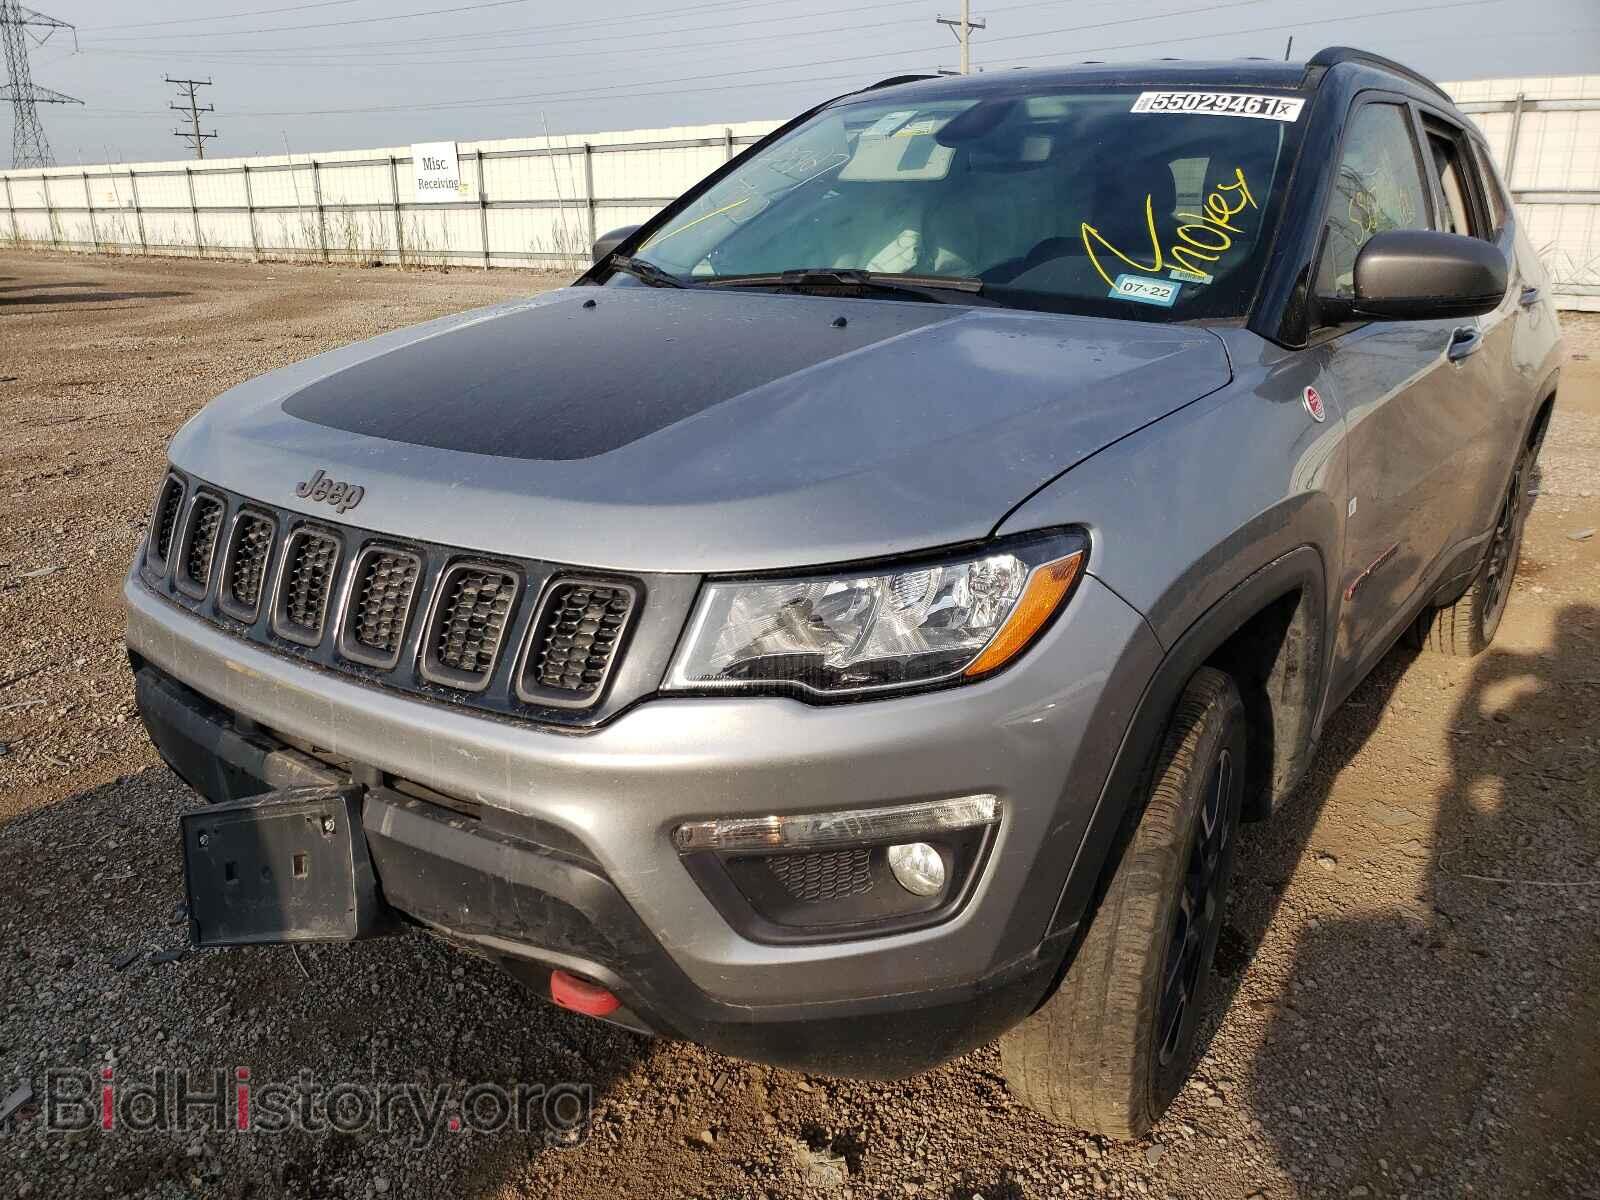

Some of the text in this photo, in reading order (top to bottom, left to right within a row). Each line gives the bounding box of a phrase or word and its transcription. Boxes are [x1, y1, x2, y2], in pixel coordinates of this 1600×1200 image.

[1152, 94, 1278, 116] 55029461
[422, 157, 449, 171] Misc.
[418, 178, 459, 191] Receiving
[295, 469, 365, 514] Jeep
